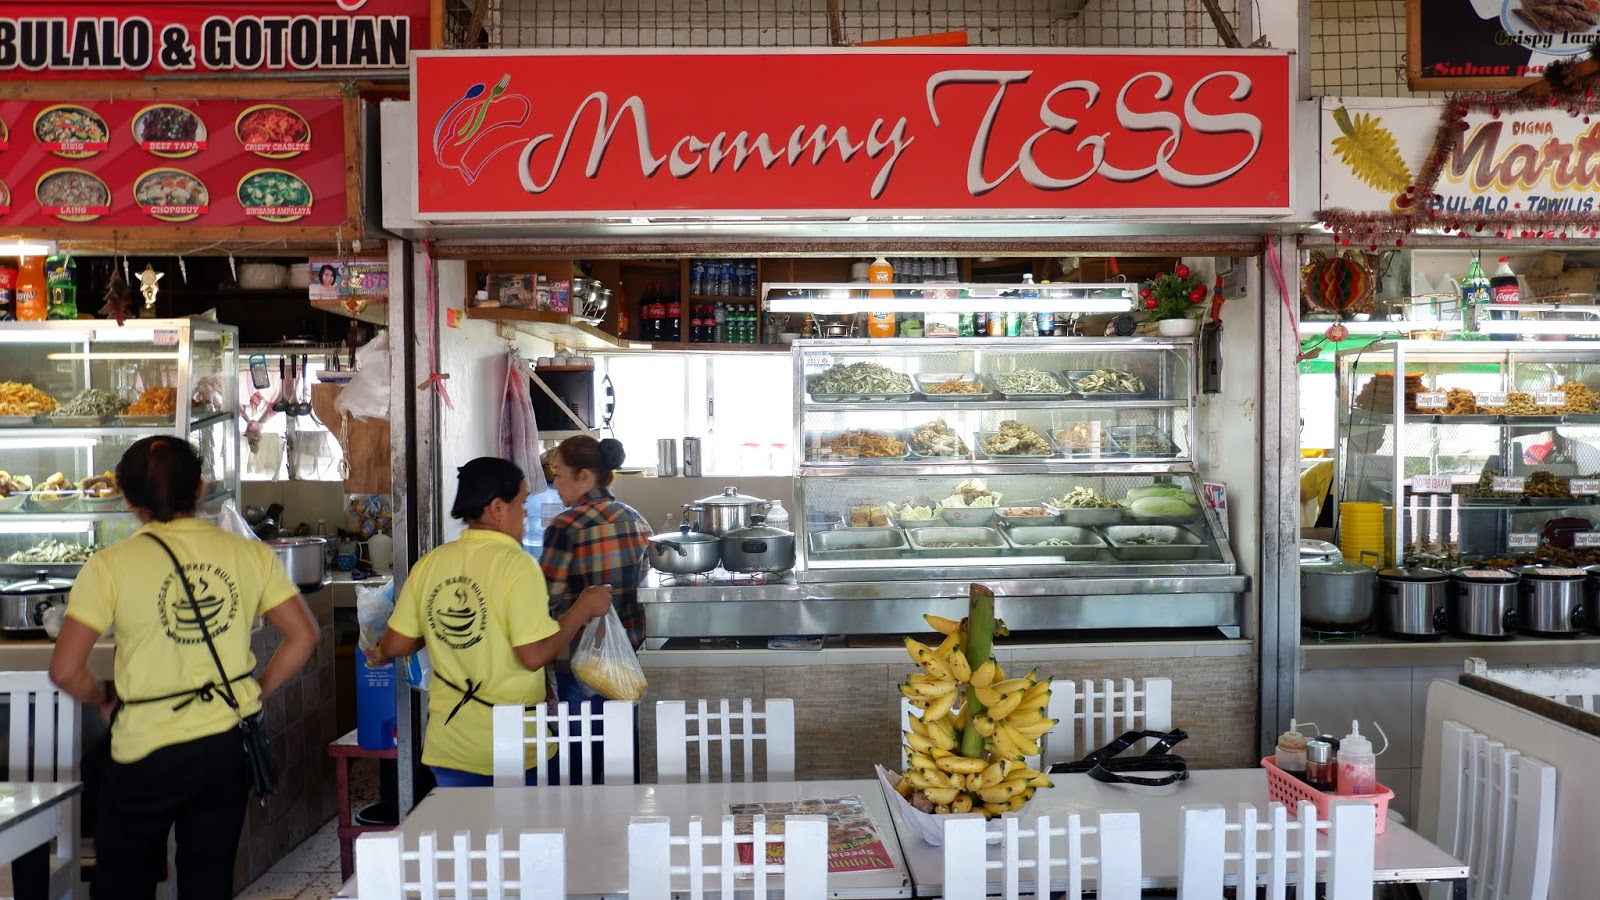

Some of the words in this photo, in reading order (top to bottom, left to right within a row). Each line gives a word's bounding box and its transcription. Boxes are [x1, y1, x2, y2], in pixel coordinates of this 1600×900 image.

[0, 16, 152, 70] BULALO
[160, 23, 196, 70] &
[201, 16, 410, 70] GOTOHAN
[1495, 30, 1553, 48] Crispy
[1433, 62, 1510, 76] Sabaw
[518, 91, 915, 201] Mommy
[925, 69, 1263, 197] TESS
[1512, 121, 1553, 136] DIGNA
[150, 142, 172, 150] BEEF
[174, 142, 199, 150] TAPA
[245, 143, 271, 151] CRISPY
[273, 143, 310, 151] CRABLETS
[1448, 120, 1600, 193] Mart
[60, 206, 87, 214] LAING
[150, 206, 199, 214] CHOPSEUY
[1429, 195, 1508, 213] BULALO
[1527, 196, 1593, 213] TAWILIS
[829, 857, 887, 869] Momm
